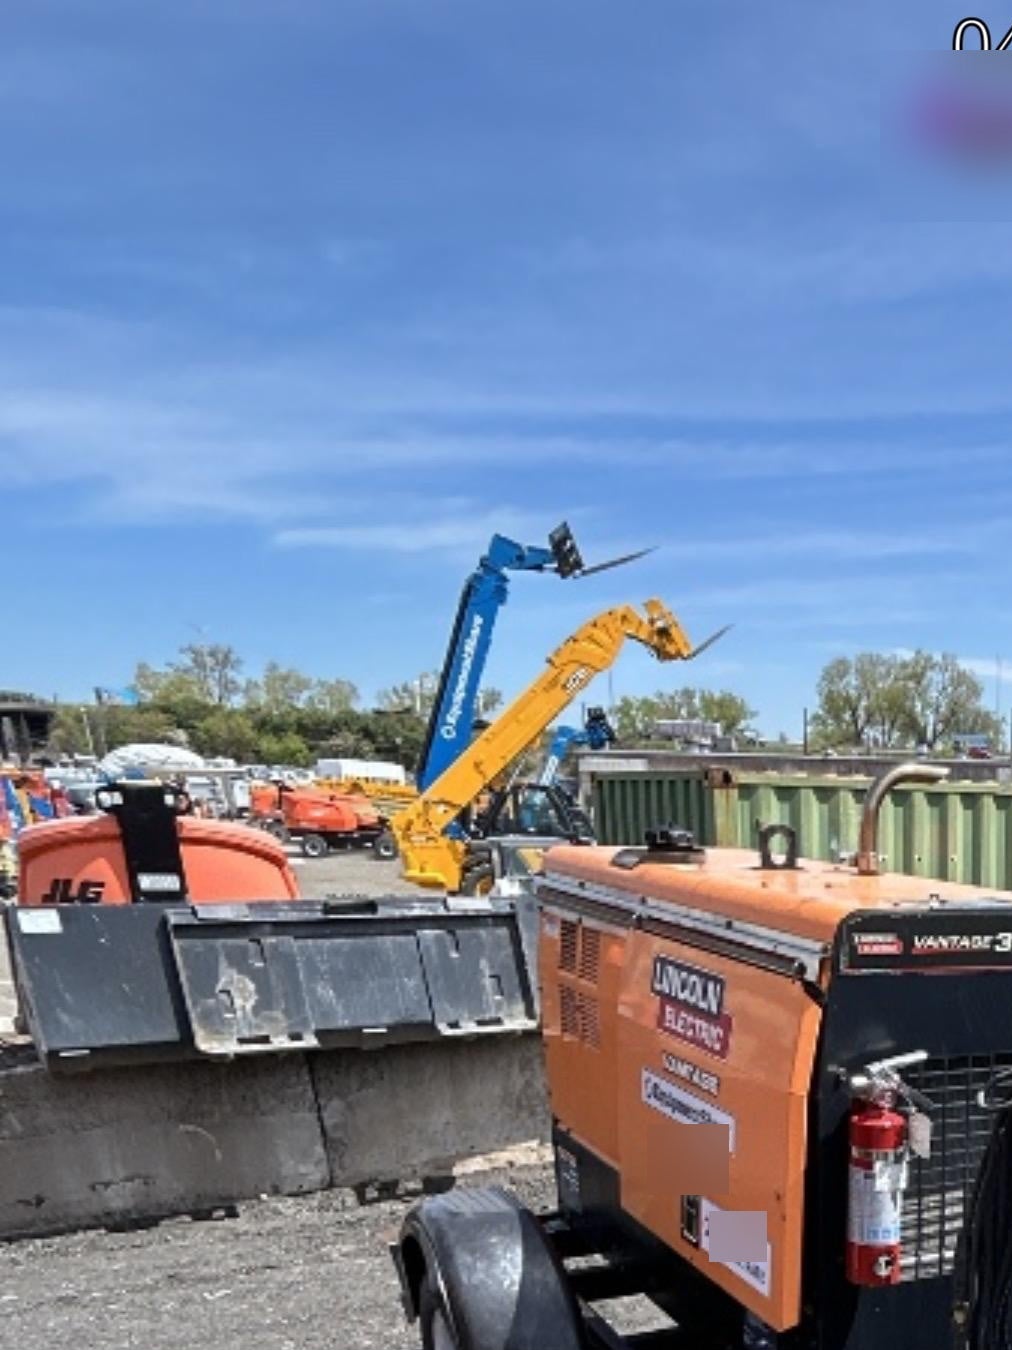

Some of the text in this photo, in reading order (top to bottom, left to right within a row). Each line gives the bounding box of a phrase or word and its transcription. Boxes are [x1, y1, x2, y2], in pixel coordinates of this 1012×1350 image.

[42, 879, 105, 902] JLG
[912, 934, 993, 949] VANTAGE
[655, 962, 721, 1015] LINCOLN
[664, 1004, 724, 1051] ELECTRIC
